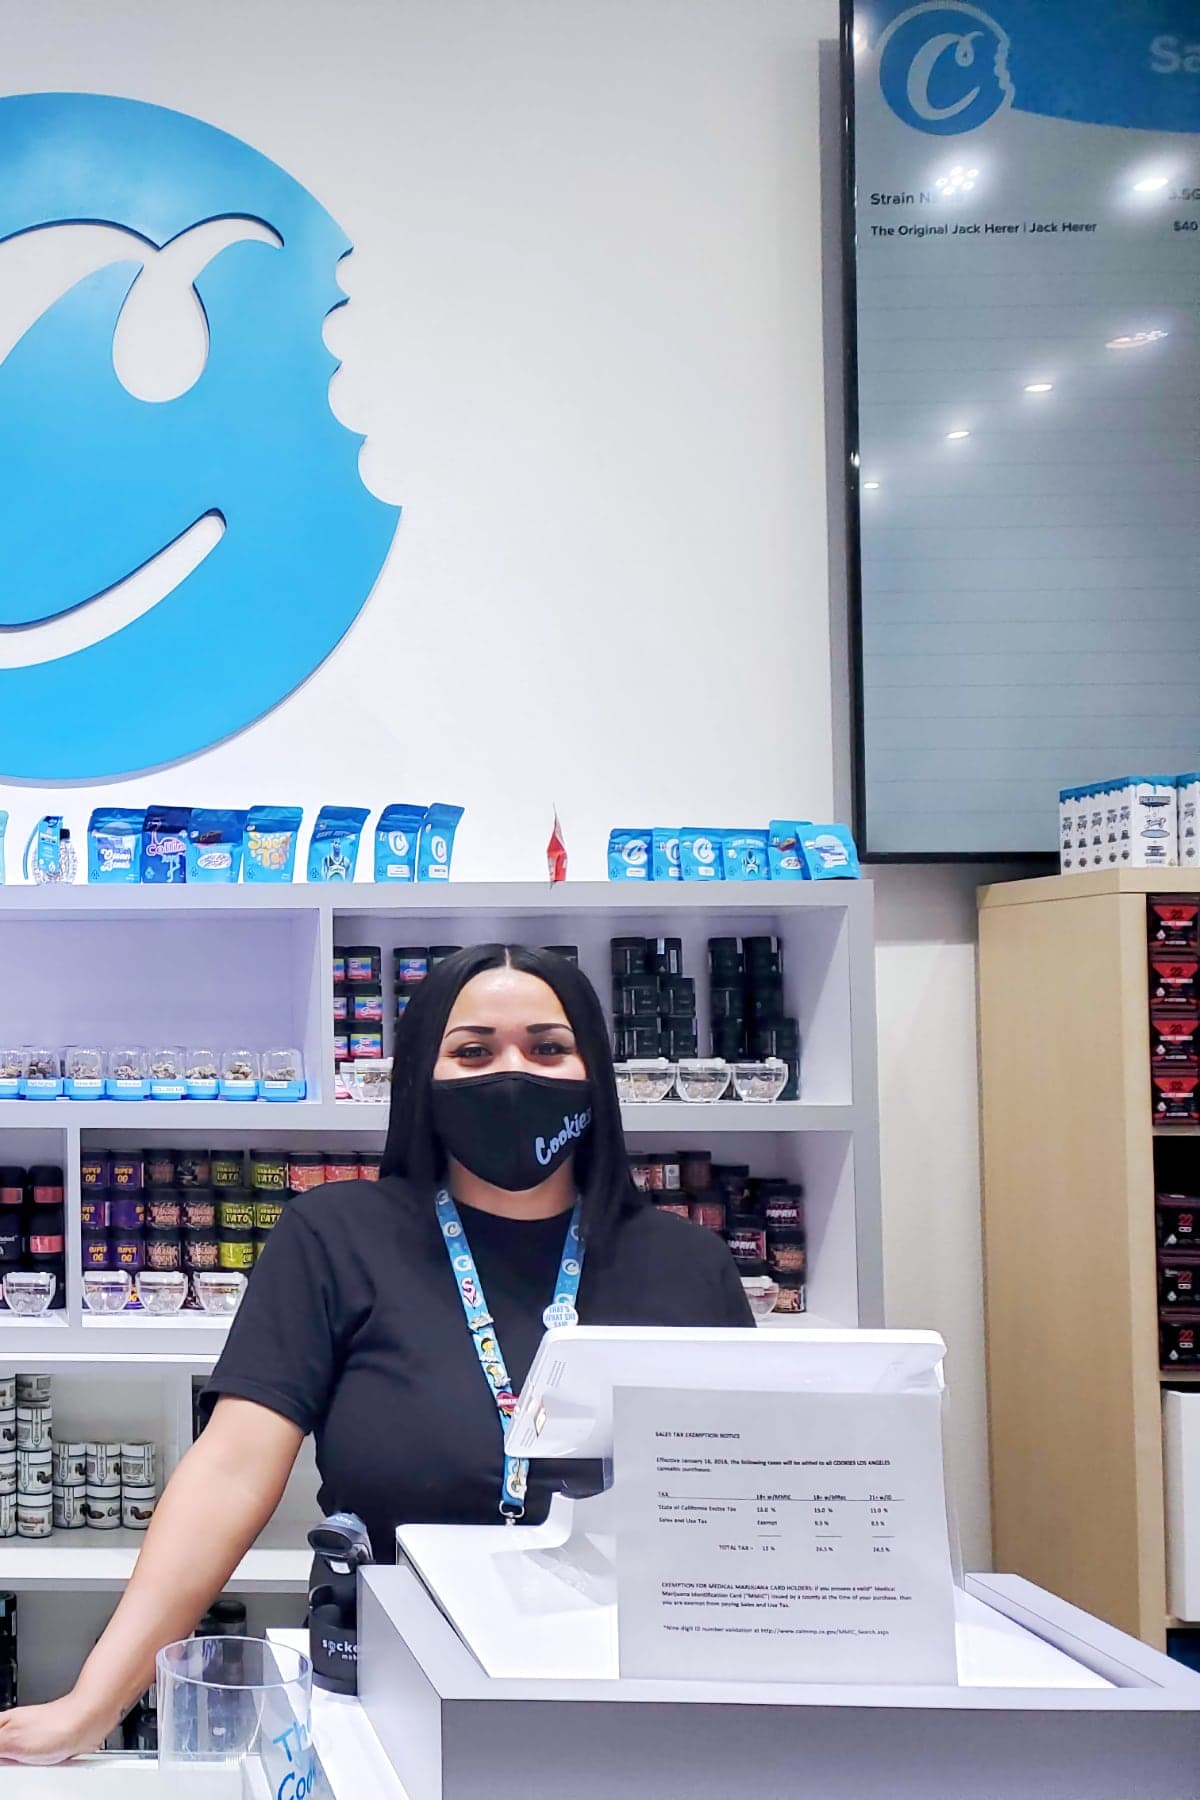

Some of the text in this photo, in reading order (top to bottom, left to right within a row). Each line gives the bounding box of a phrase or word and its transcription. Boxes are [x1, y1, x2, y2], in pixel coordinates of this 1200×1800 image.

[870, 192, 914, 206] Strain
[870, 222, 1097, 238] The Original Jack Herer Jack Herer
